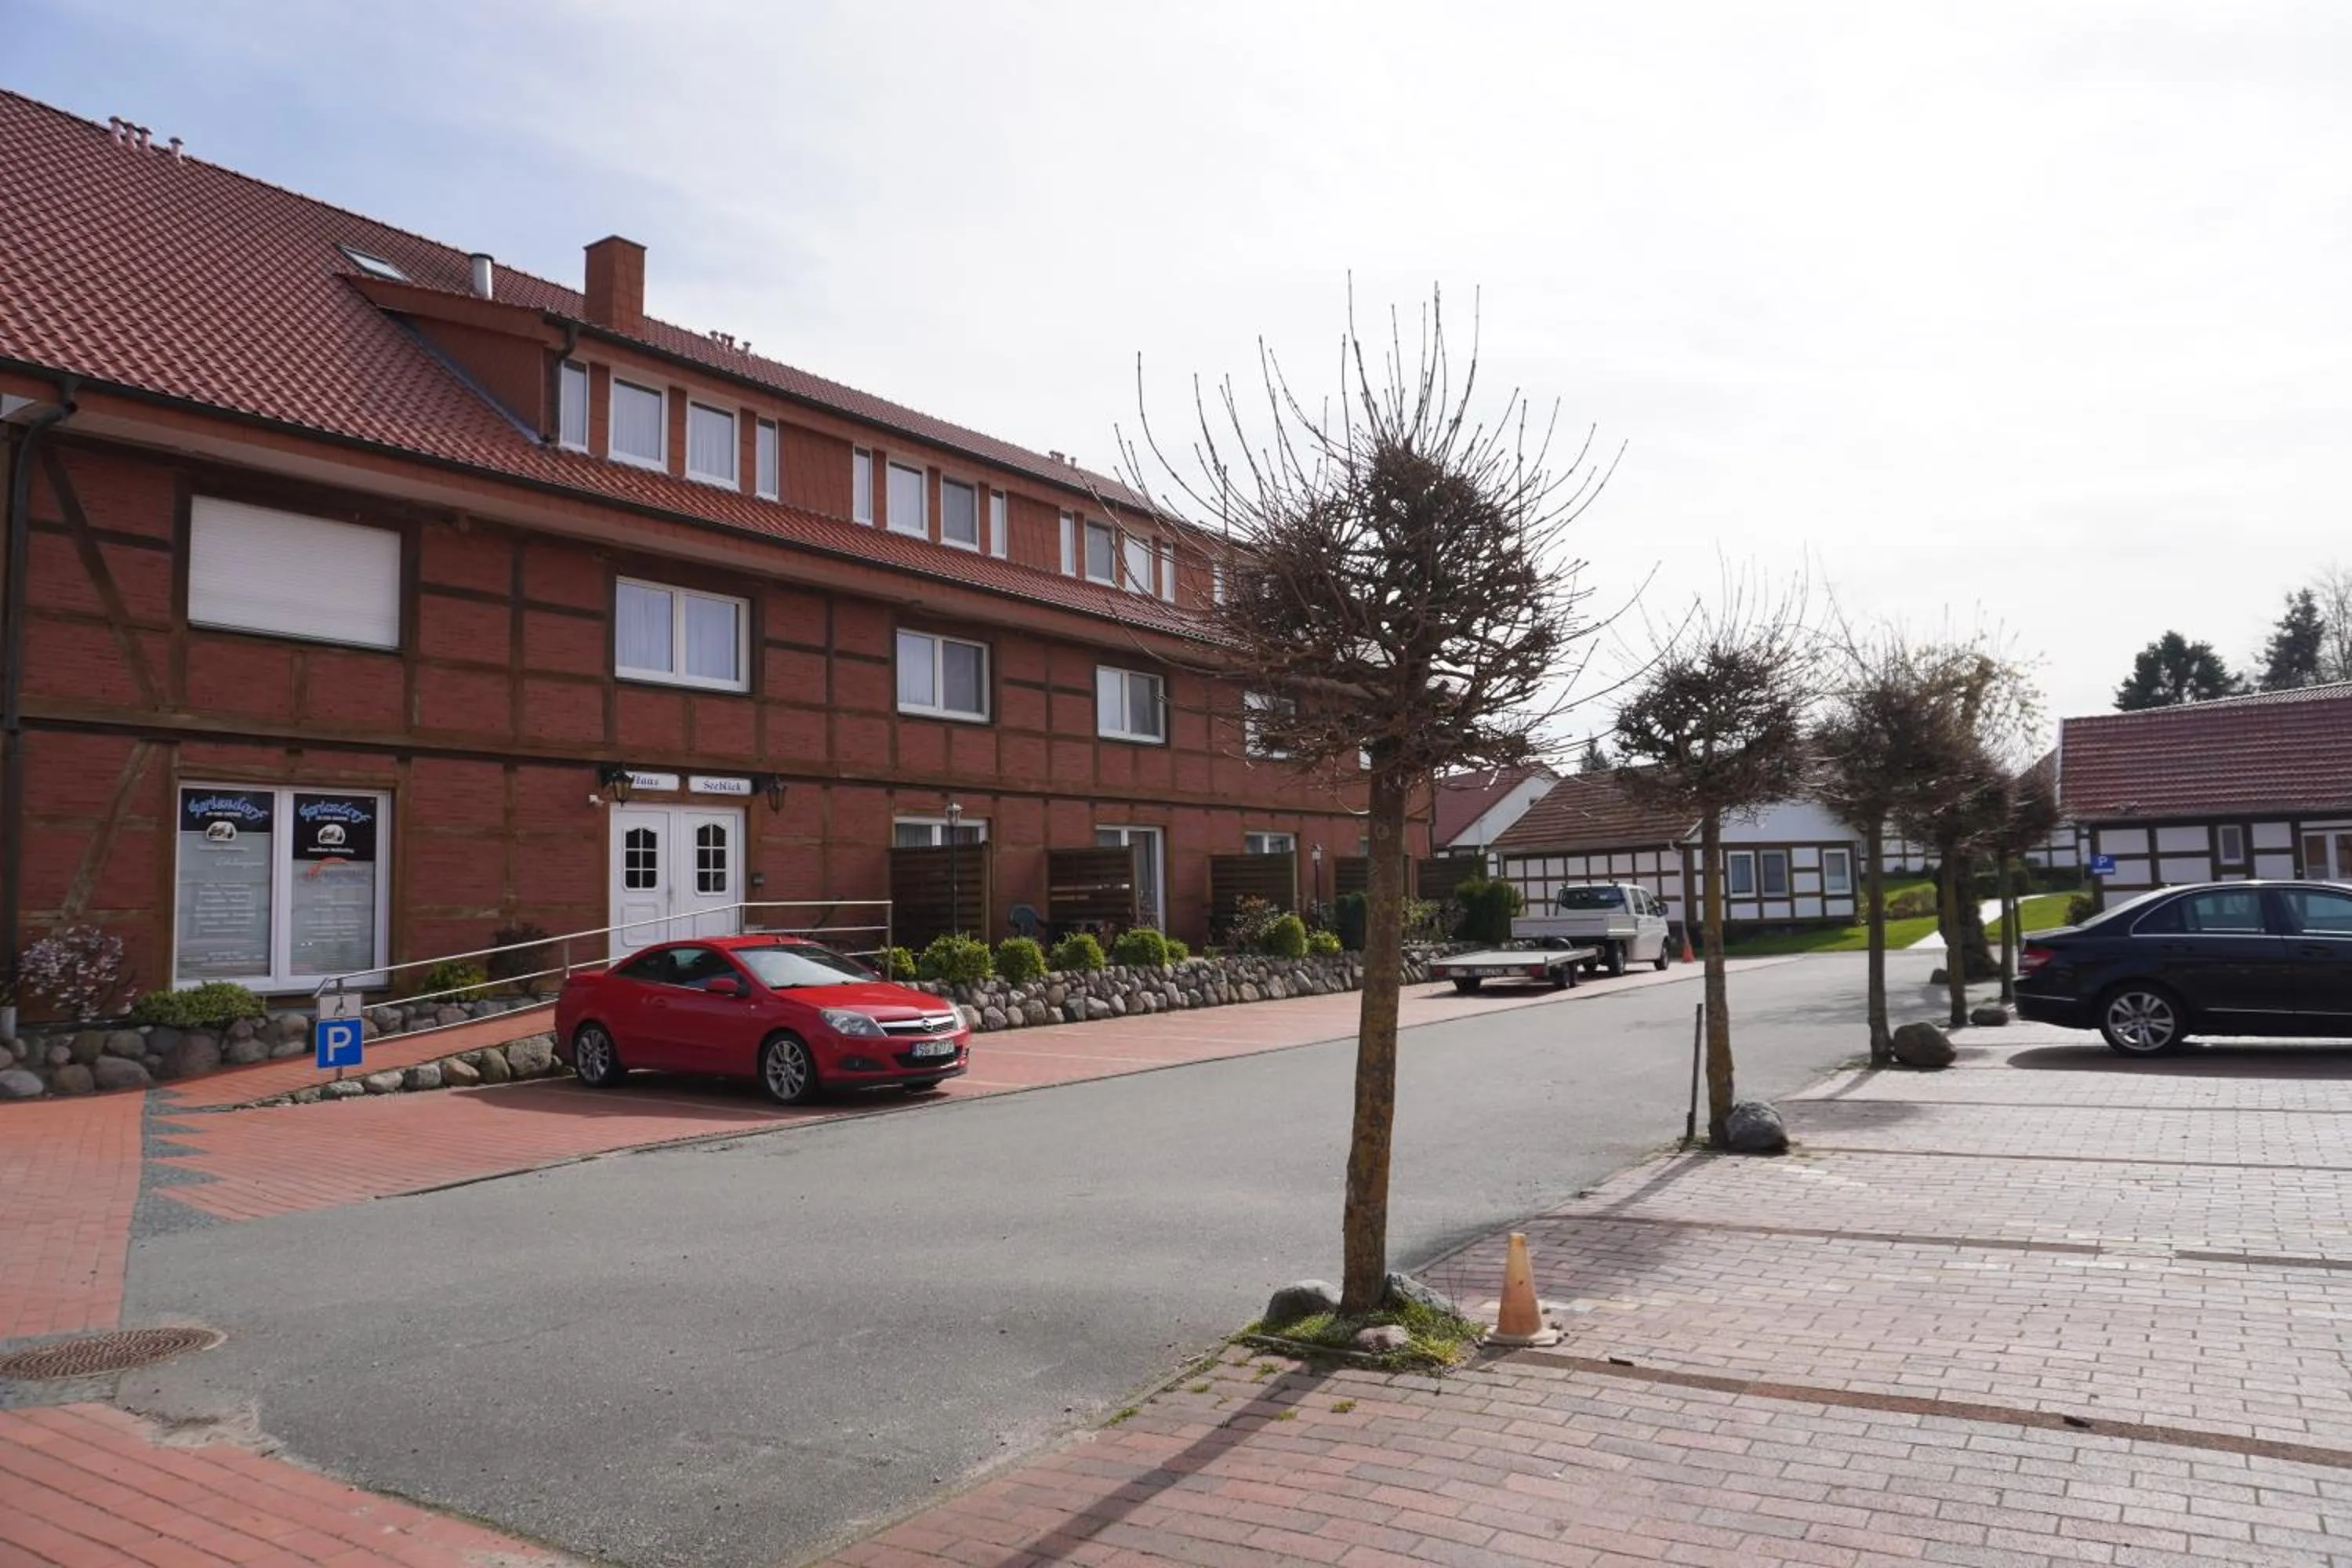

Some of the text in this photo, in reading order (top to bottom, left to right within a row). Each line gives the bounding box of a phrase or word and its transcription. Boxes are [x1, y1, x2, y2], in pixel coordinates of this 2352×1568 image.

[702, 780, 741, 792] Seeblick
[2098, 855, 2108, 866] P
[327, 1026, 352, 1062] P
